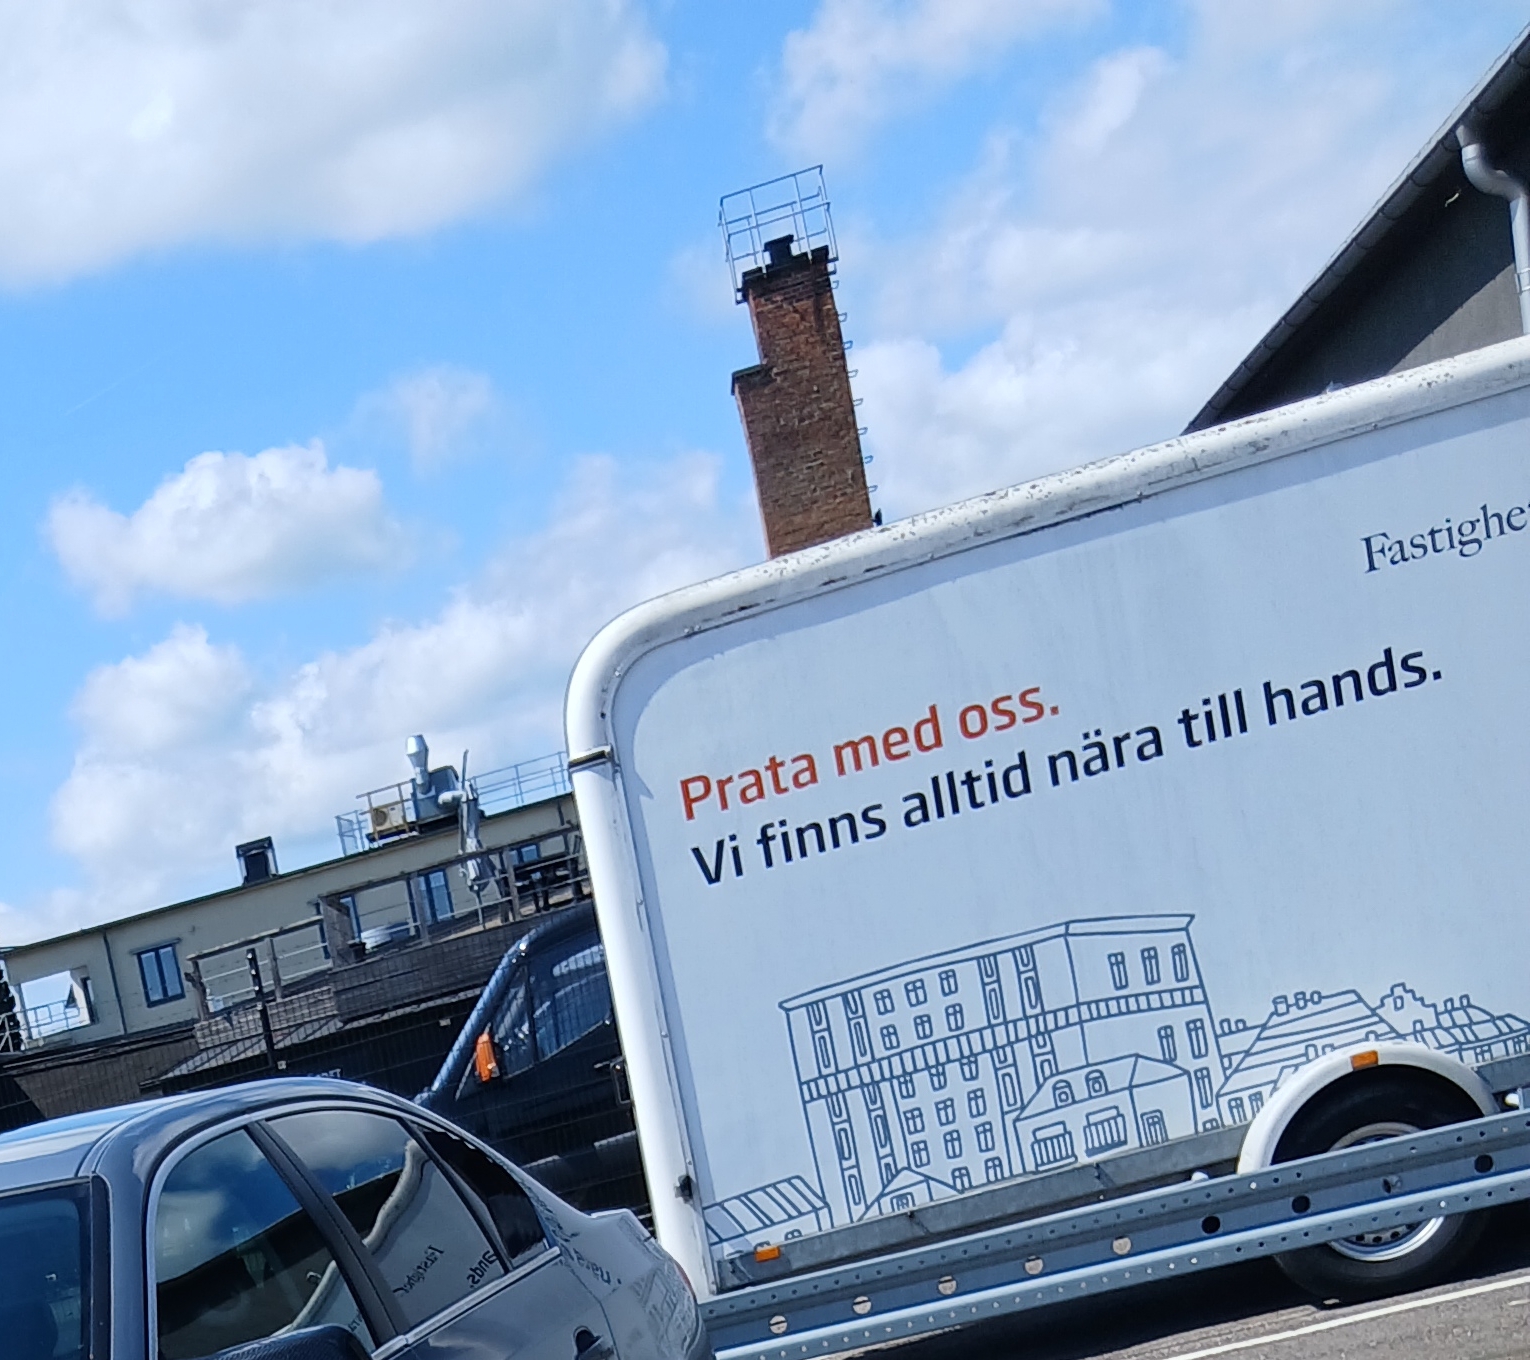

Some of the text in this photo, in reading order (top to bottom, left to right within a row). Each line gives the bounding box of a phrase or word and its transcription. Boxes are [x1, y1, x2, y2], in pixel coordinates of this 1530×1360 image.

[1361, 501, 1530, 574] Fastighe
[680, 686, 1059, 821] Prata med oss.
[691, 646, 1443, 885] Vi finns alltid nära till hands.
